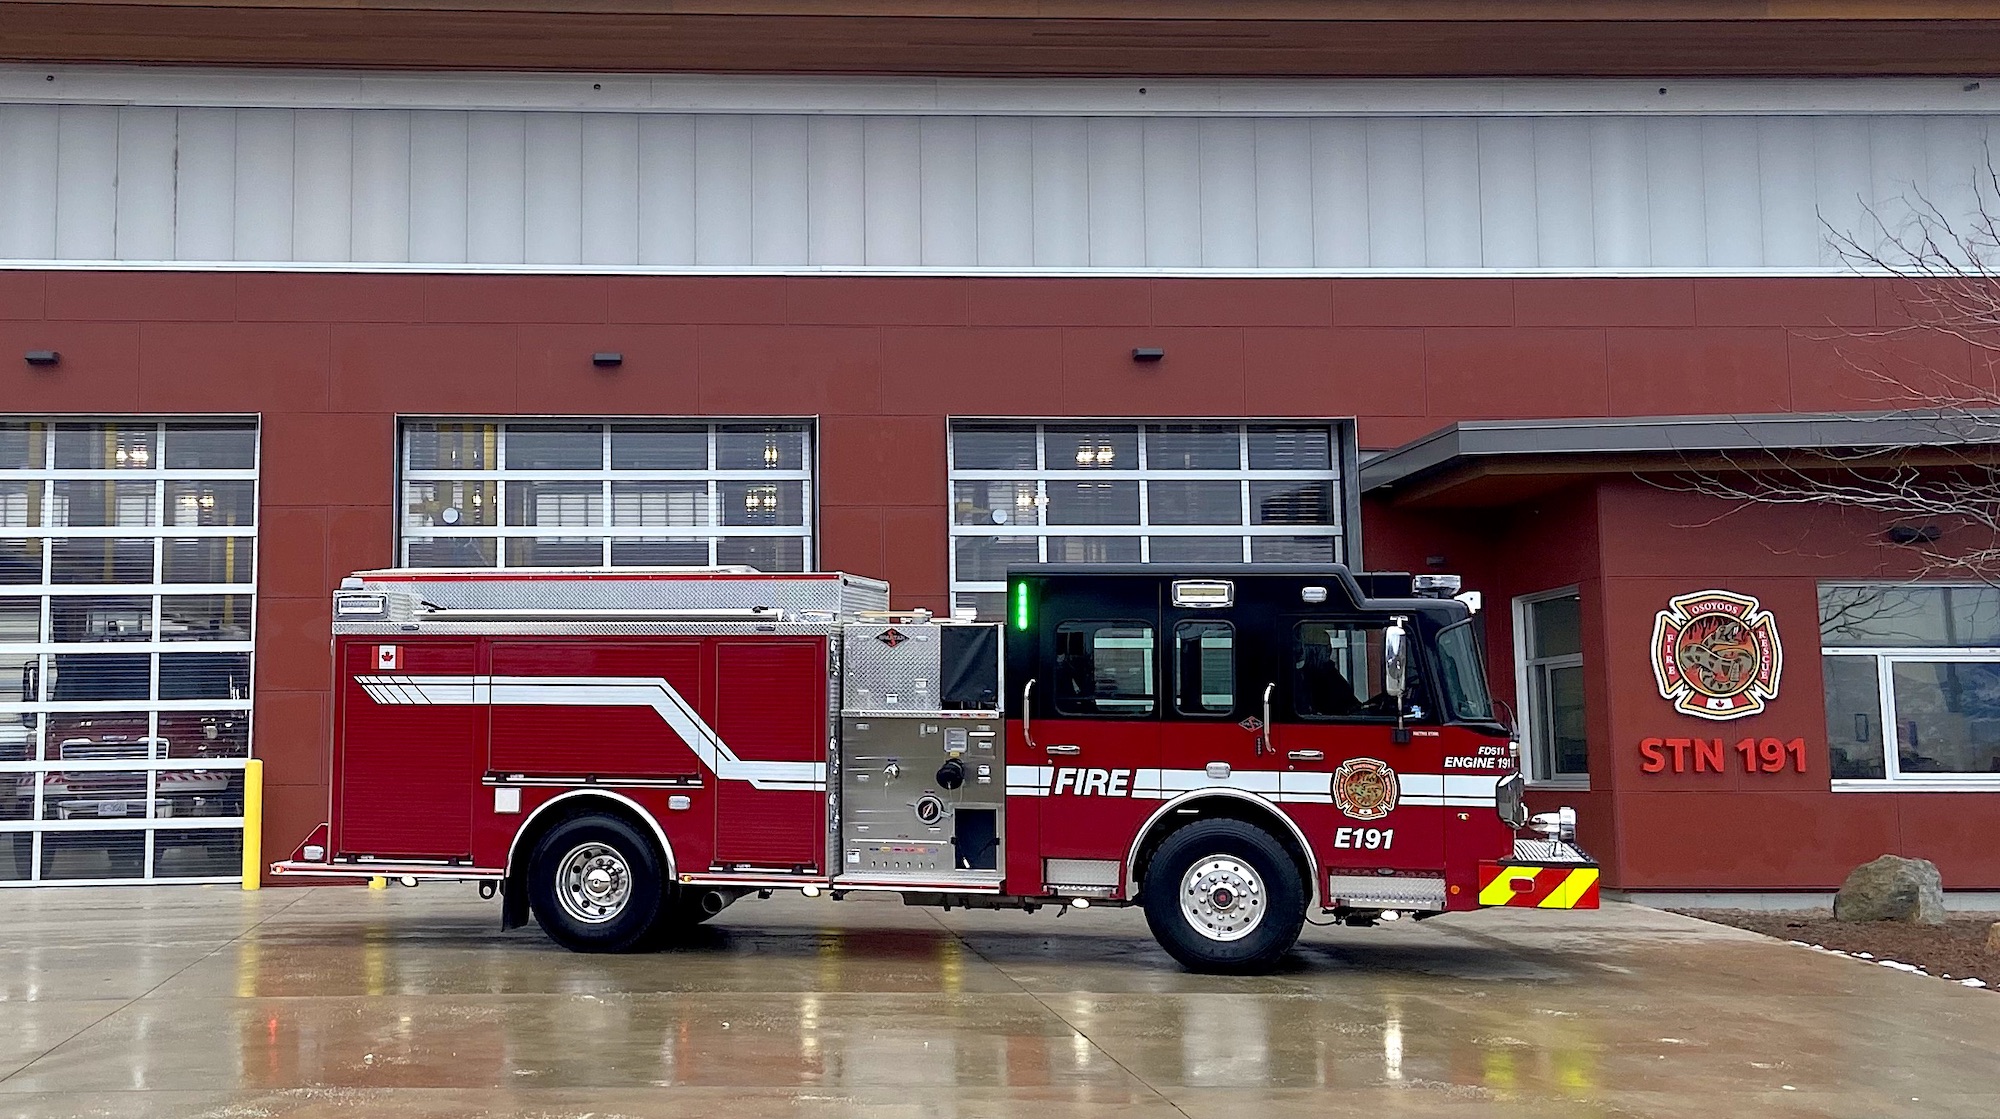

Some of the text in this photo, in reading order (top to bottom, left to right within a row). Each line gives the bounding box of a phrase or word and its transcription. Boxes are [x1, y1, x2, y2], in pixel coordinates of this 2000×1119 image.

[1692, 602, 1738, 614] OSOYOOS
[1666, 634, 1675, 675] FIRE
[1758, 631, 1770, 680] RESCUE
[1443, 756, 1511, 769] ENGINE 191
[1477, 745, 1505, 756] FD511
[1639, 737, 1806, 773] STN 191
[1054, 767, 1131, 797] FIRE
[1333, 827, 1394, 850] E191
